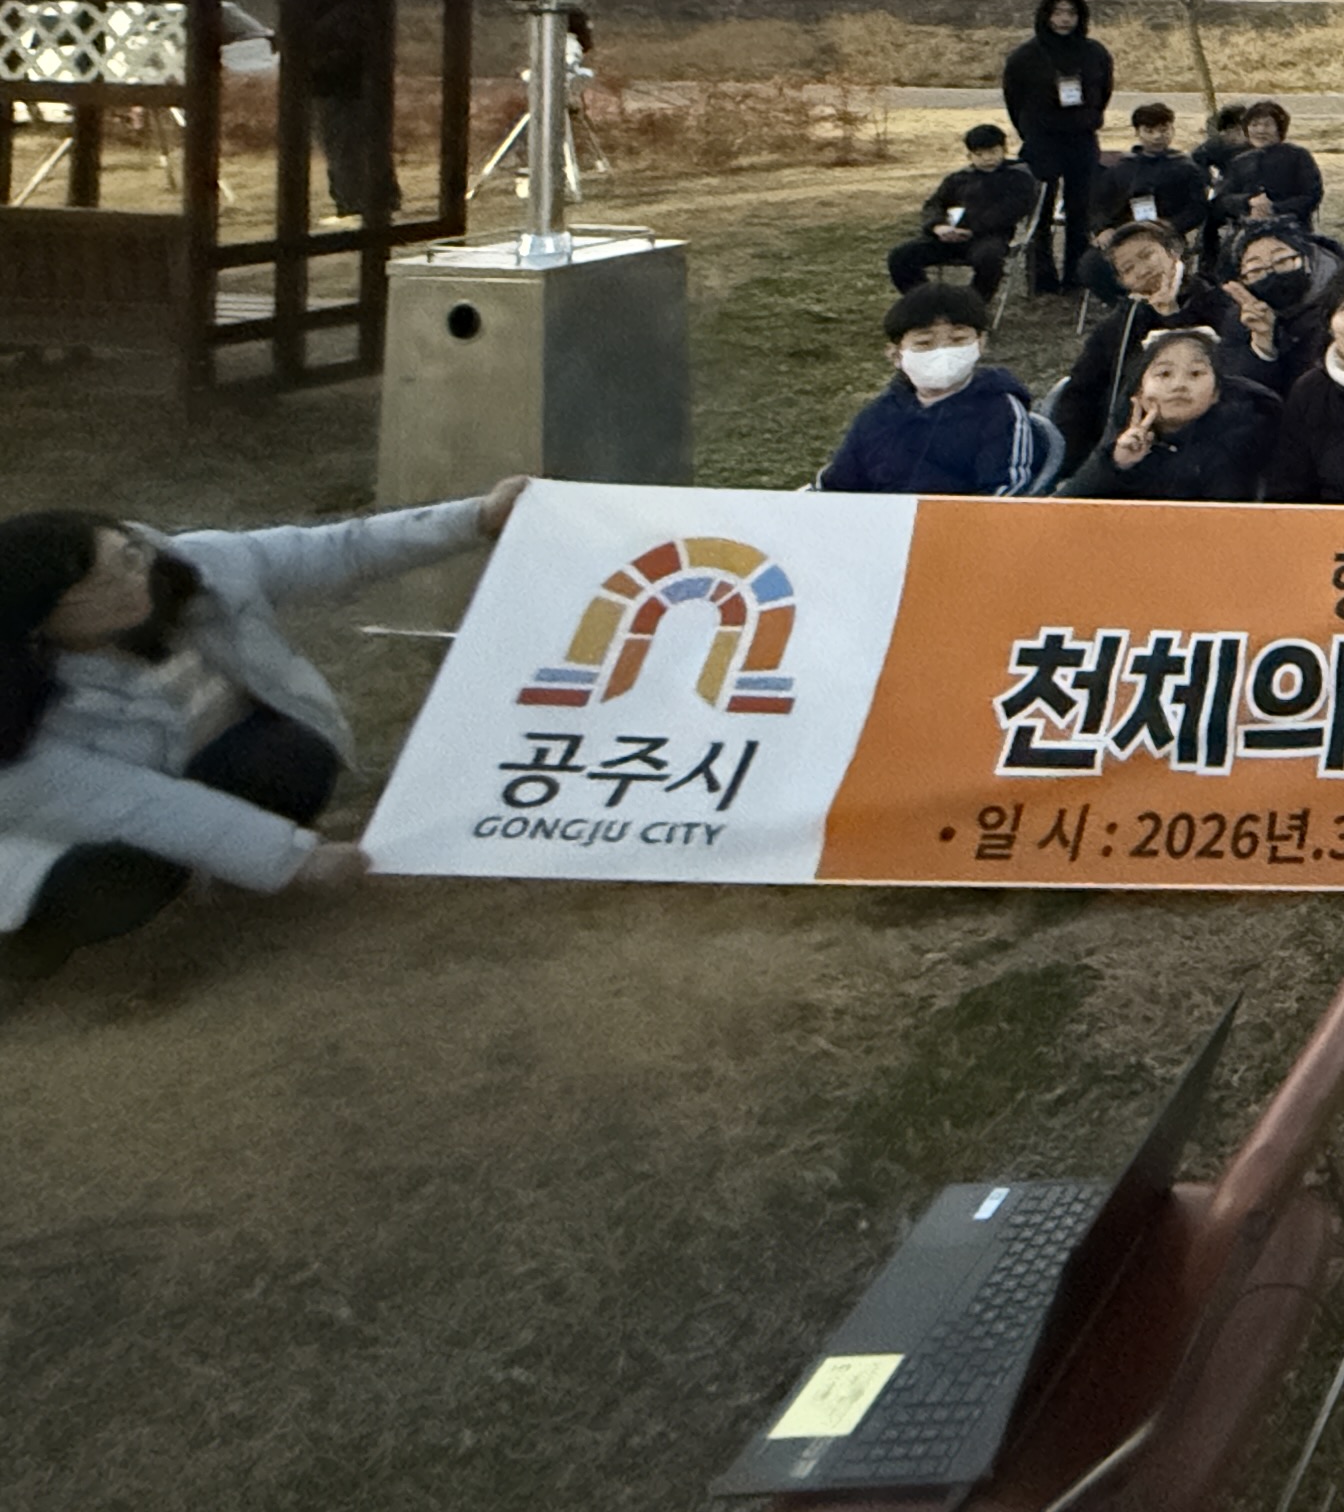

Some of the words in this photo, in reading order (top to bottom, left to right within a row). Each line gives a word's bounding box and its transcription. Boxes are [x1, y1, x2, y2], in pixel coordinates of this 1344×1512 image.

[498, 732, 760, 812] 공주시
[473, 815, 632, 847] GONGJU
[640, 821, 726, 846] CITY
